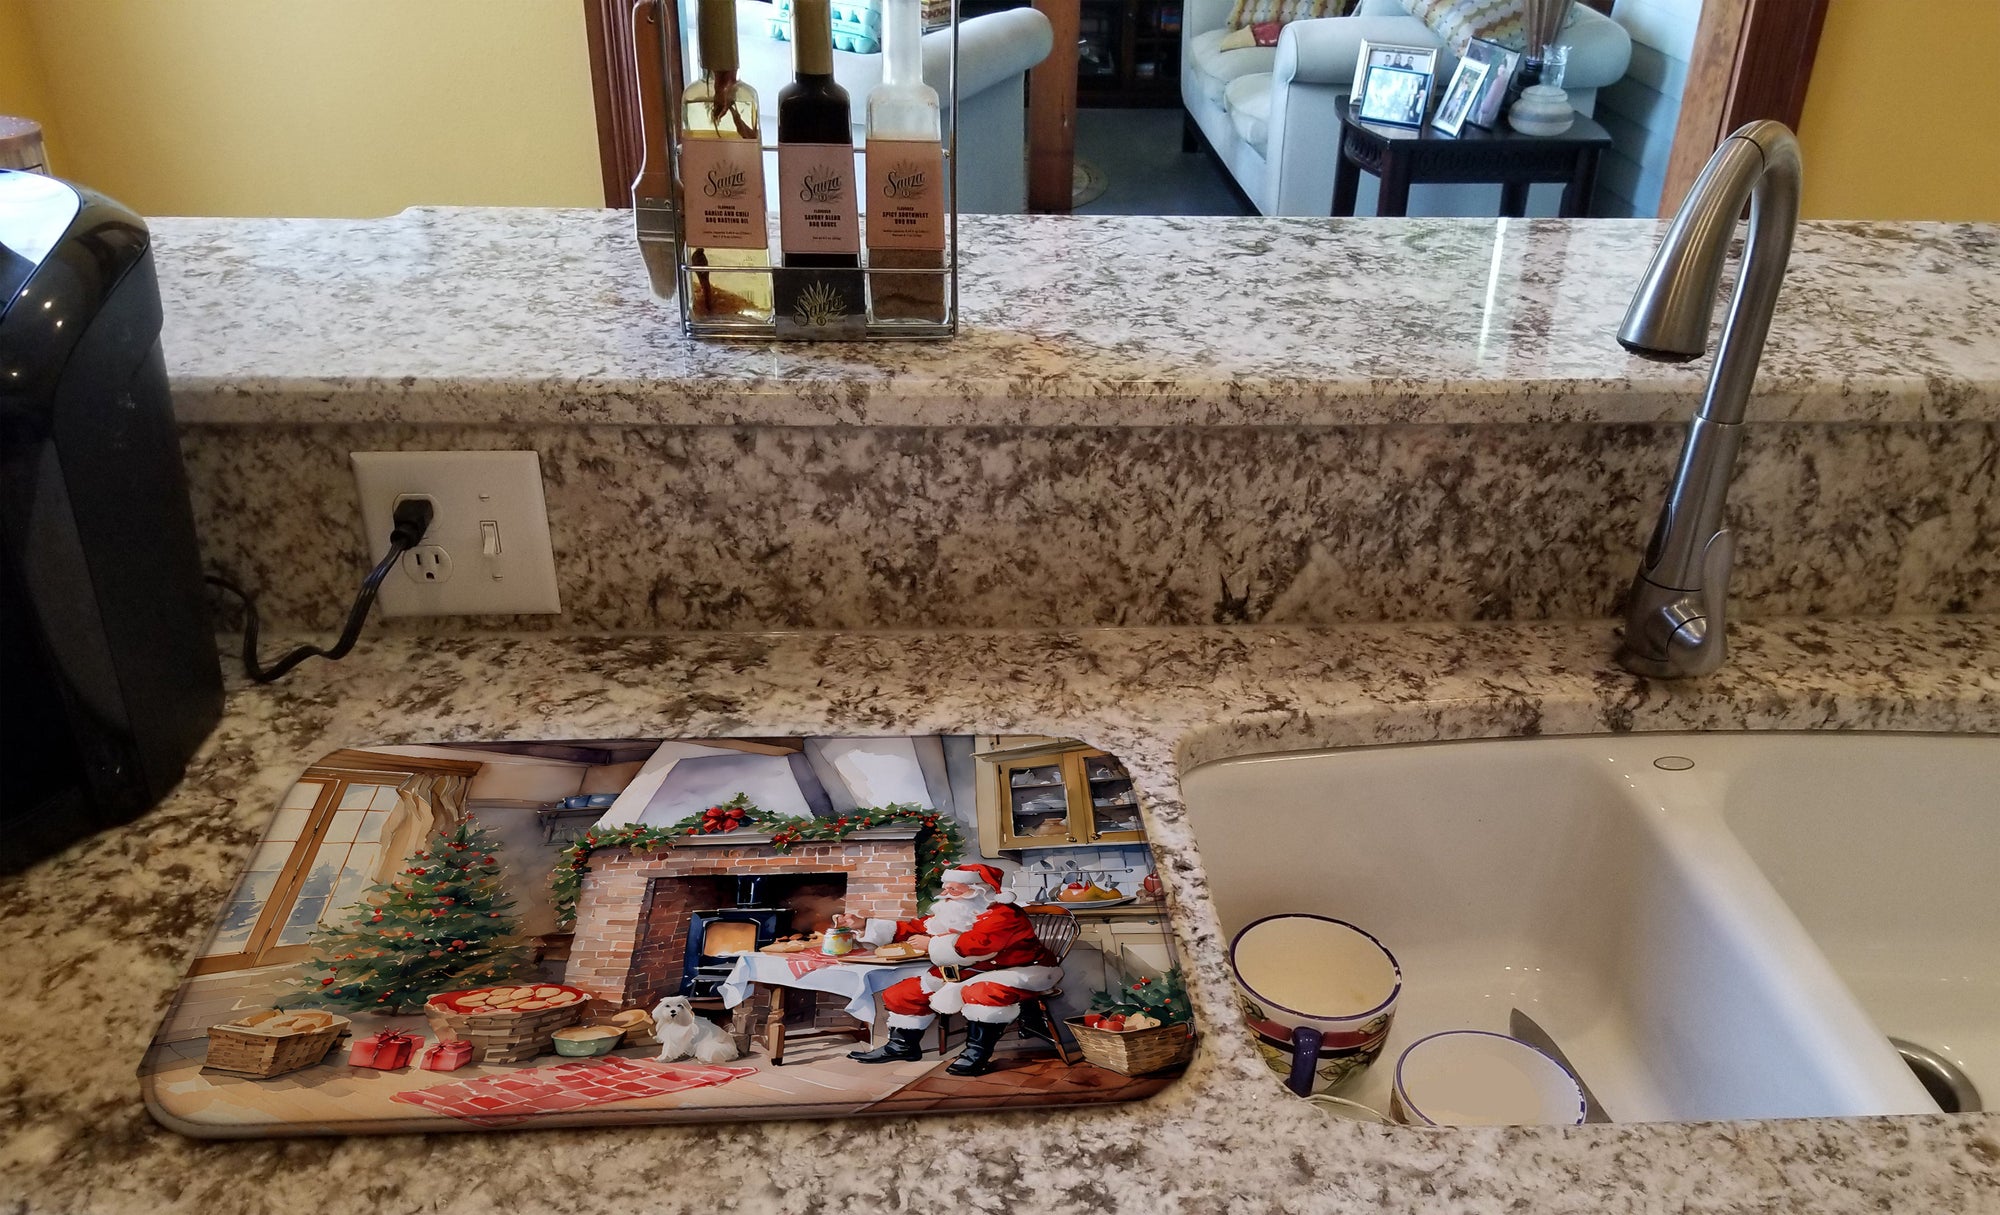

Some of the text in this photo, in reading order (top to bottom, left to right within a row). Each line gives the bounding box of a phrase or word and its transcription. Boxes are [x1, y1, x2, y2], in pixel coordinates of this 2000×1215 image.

[704, 170, 746, 197] Sauza
[800, 175, 842, 202] Sauza
[884, 171, 926, 198] Sauza
